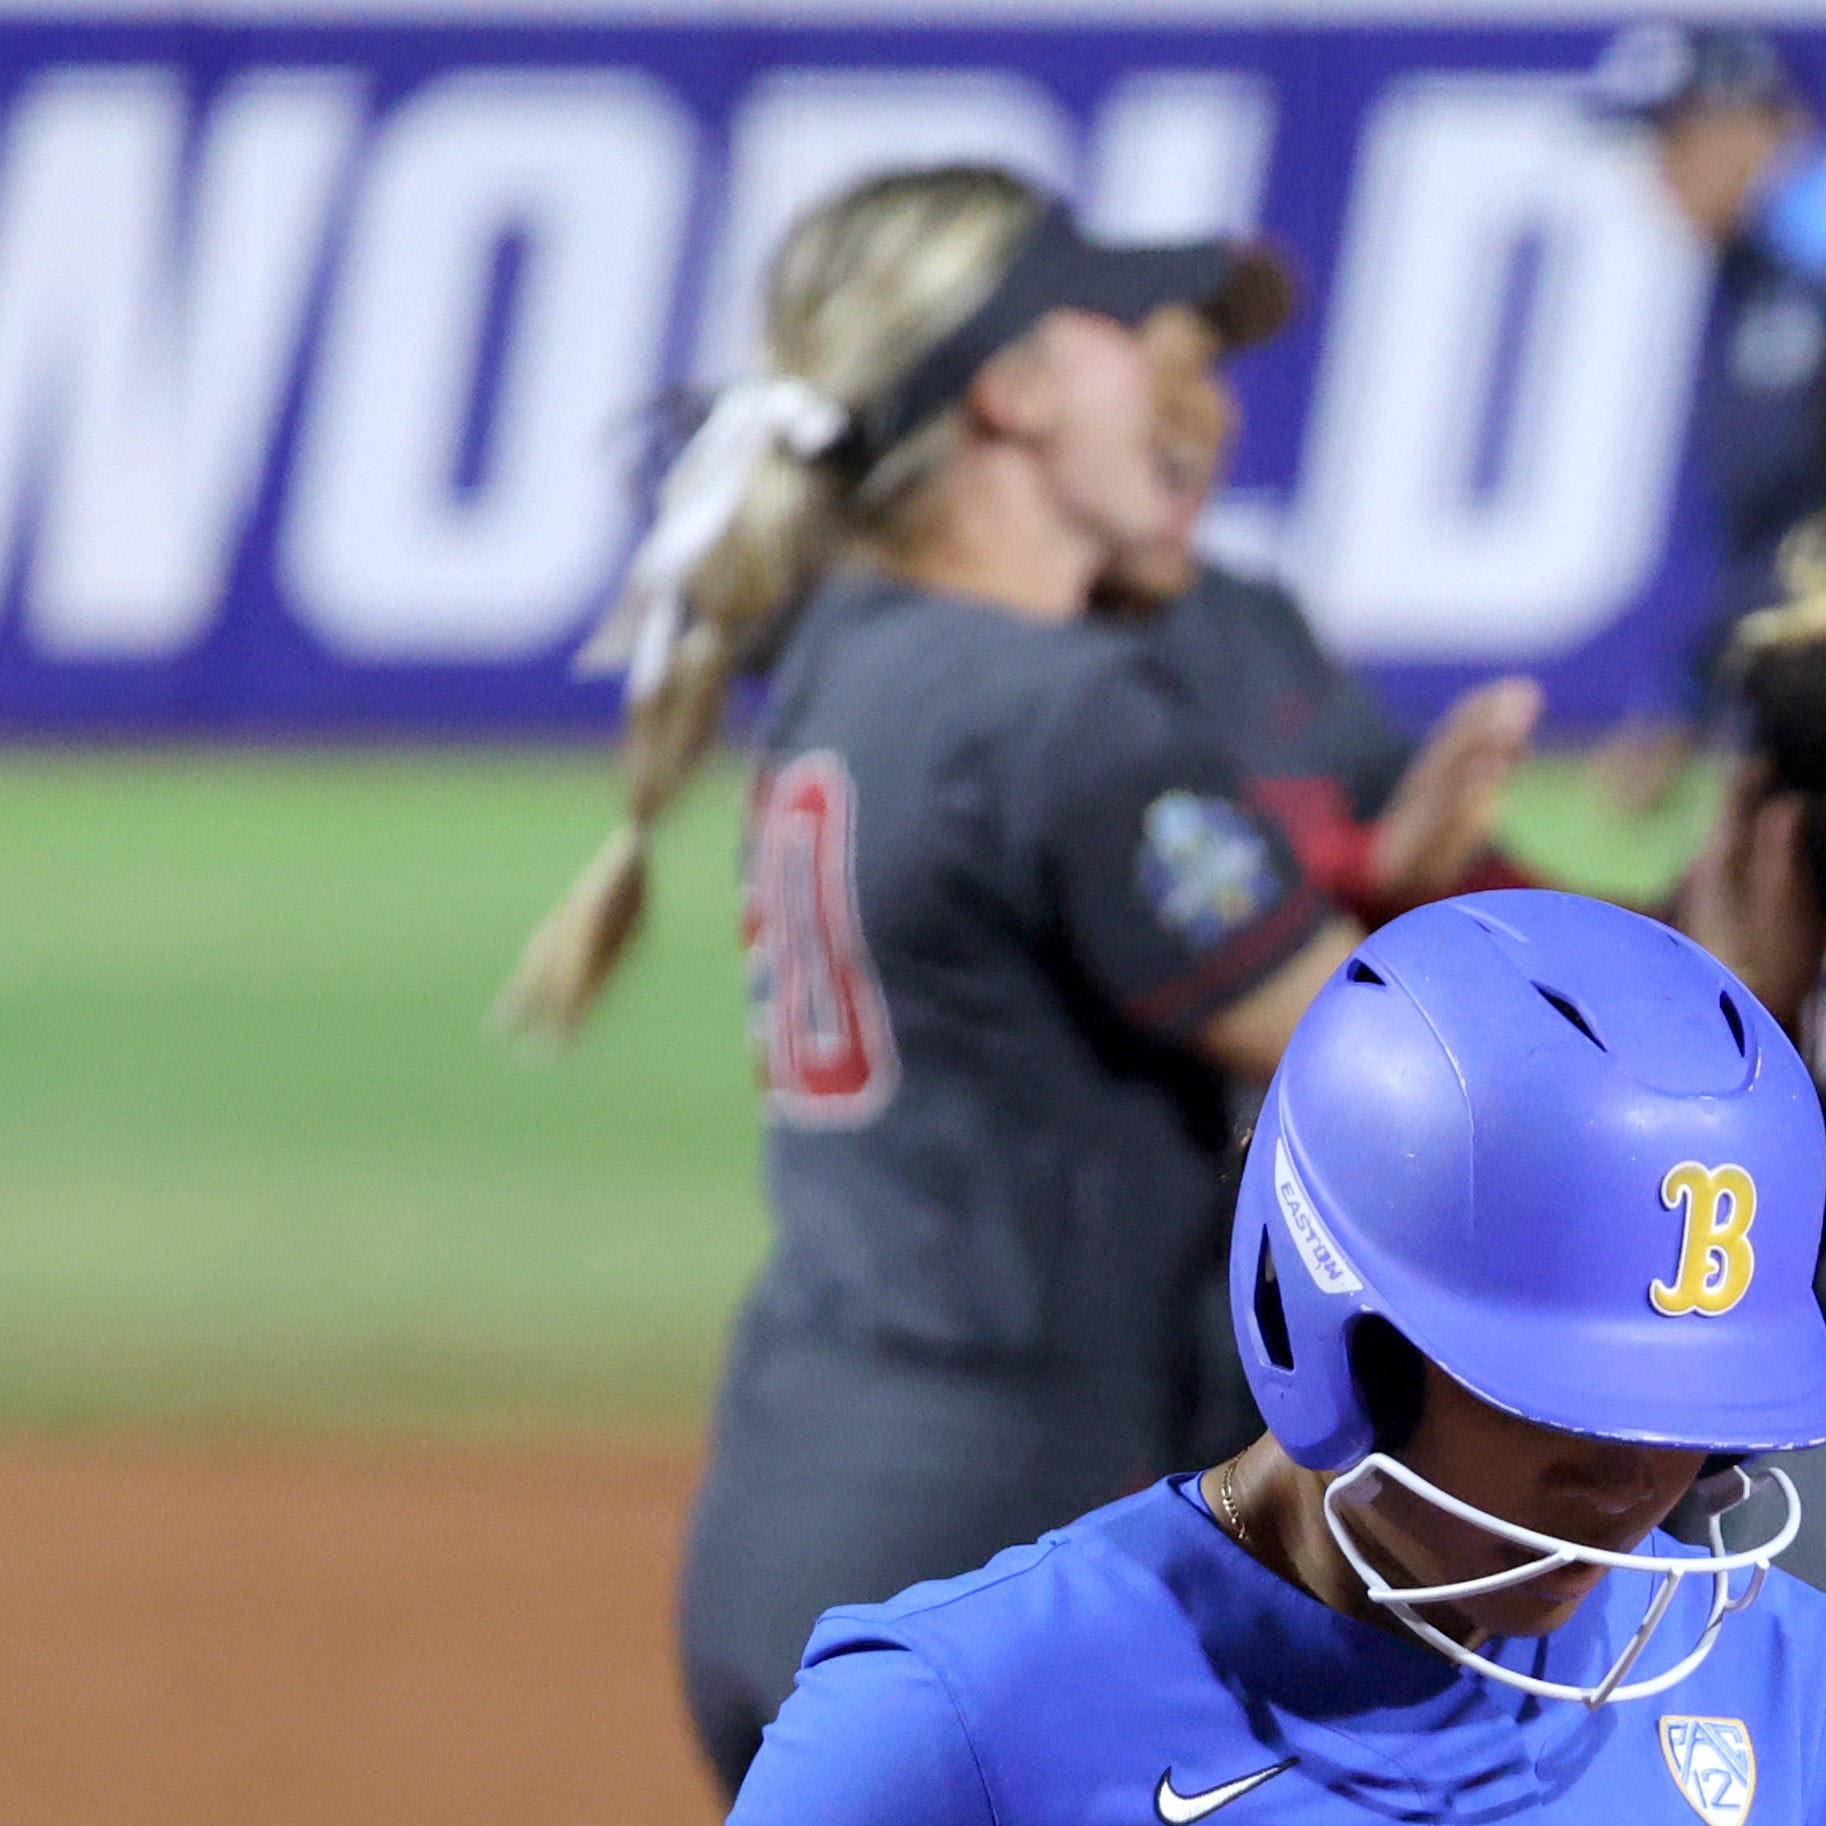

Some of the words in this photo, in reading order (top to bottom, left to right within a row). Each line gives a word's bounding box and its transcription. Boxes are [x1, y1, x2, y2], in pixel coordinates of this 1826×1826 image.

[740, 748, 900, 1130] 0
[1280, 1181, 1344, 1281] EASTON
[1650, 1160, 1757, 1317] B
